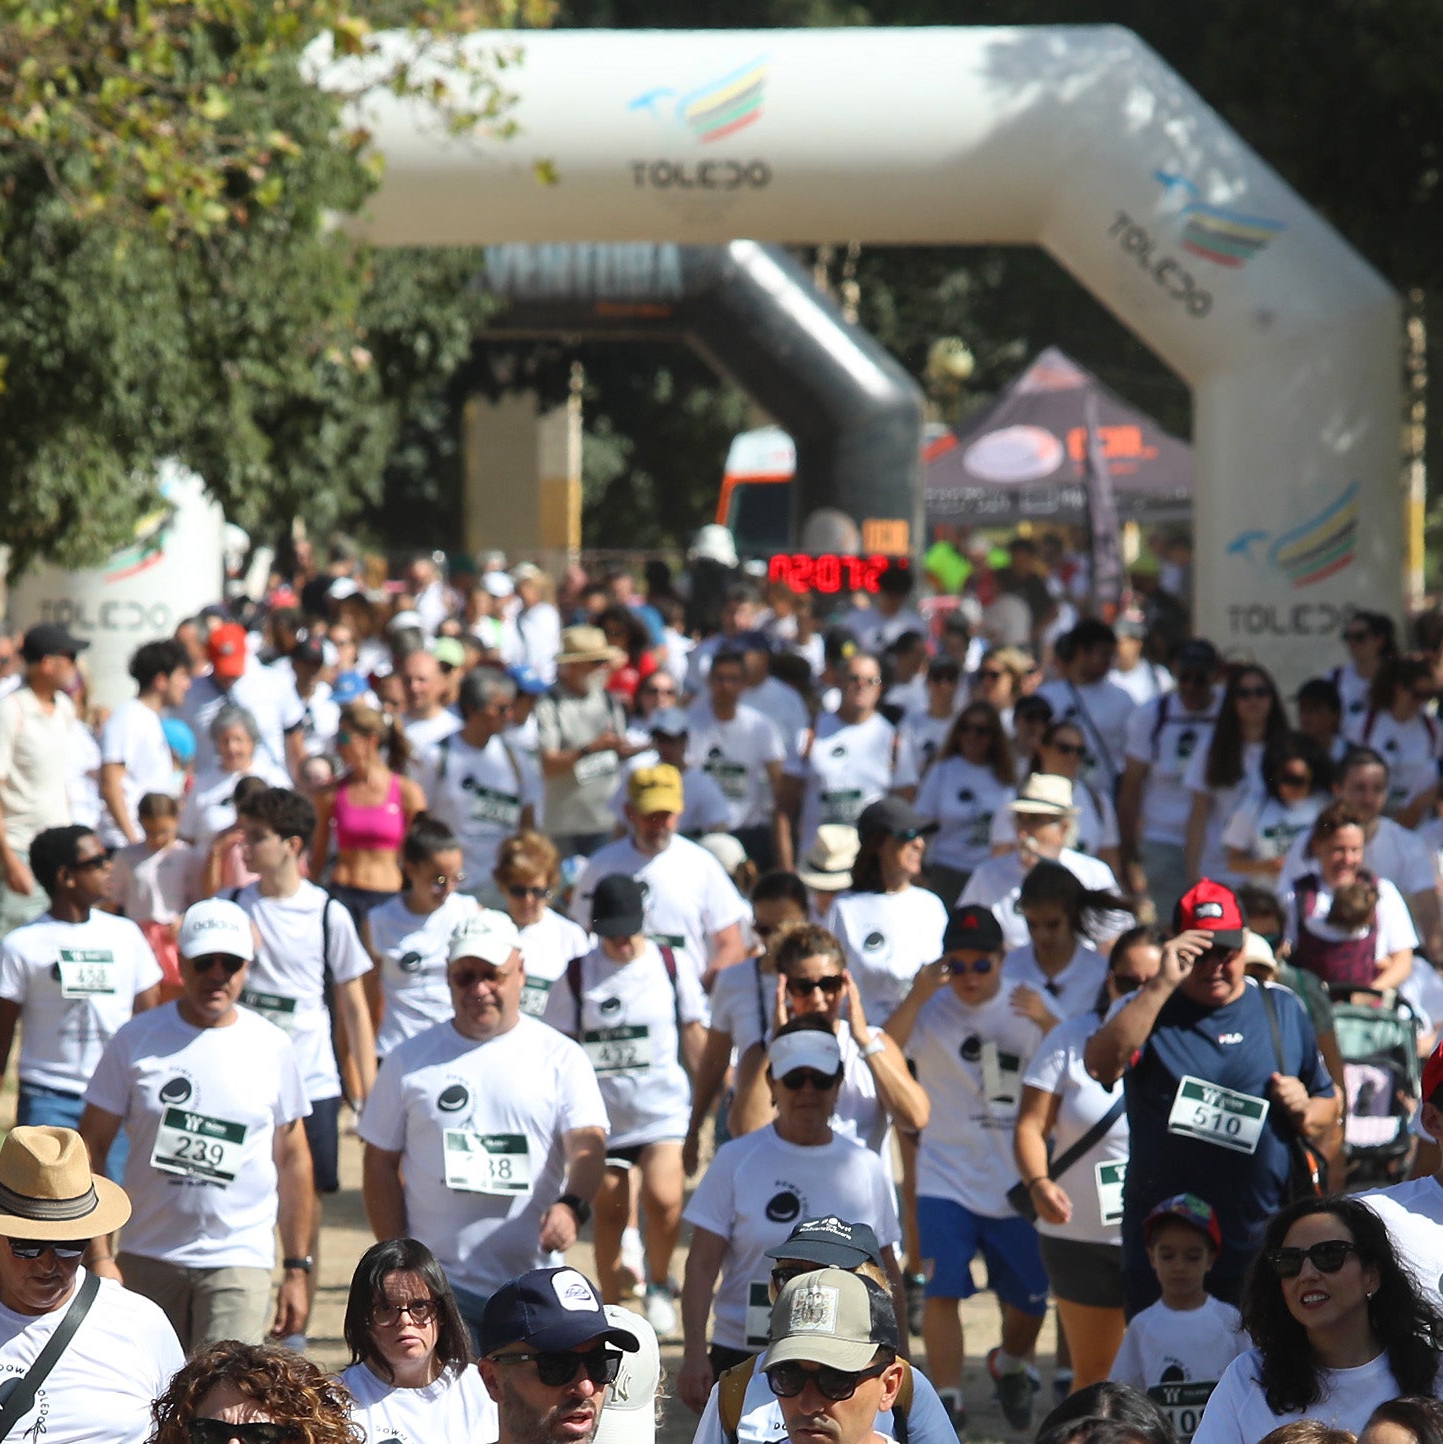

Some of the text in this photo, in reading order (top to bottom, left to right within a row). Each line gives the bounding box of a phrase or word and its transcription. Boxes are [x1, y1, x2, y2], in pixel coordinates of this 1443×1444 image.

[1192, 1106, 1242, 1136] 510
[175, 1136, 224, 1166] 239
[37, 1390, 48, 1423] OLEDO
